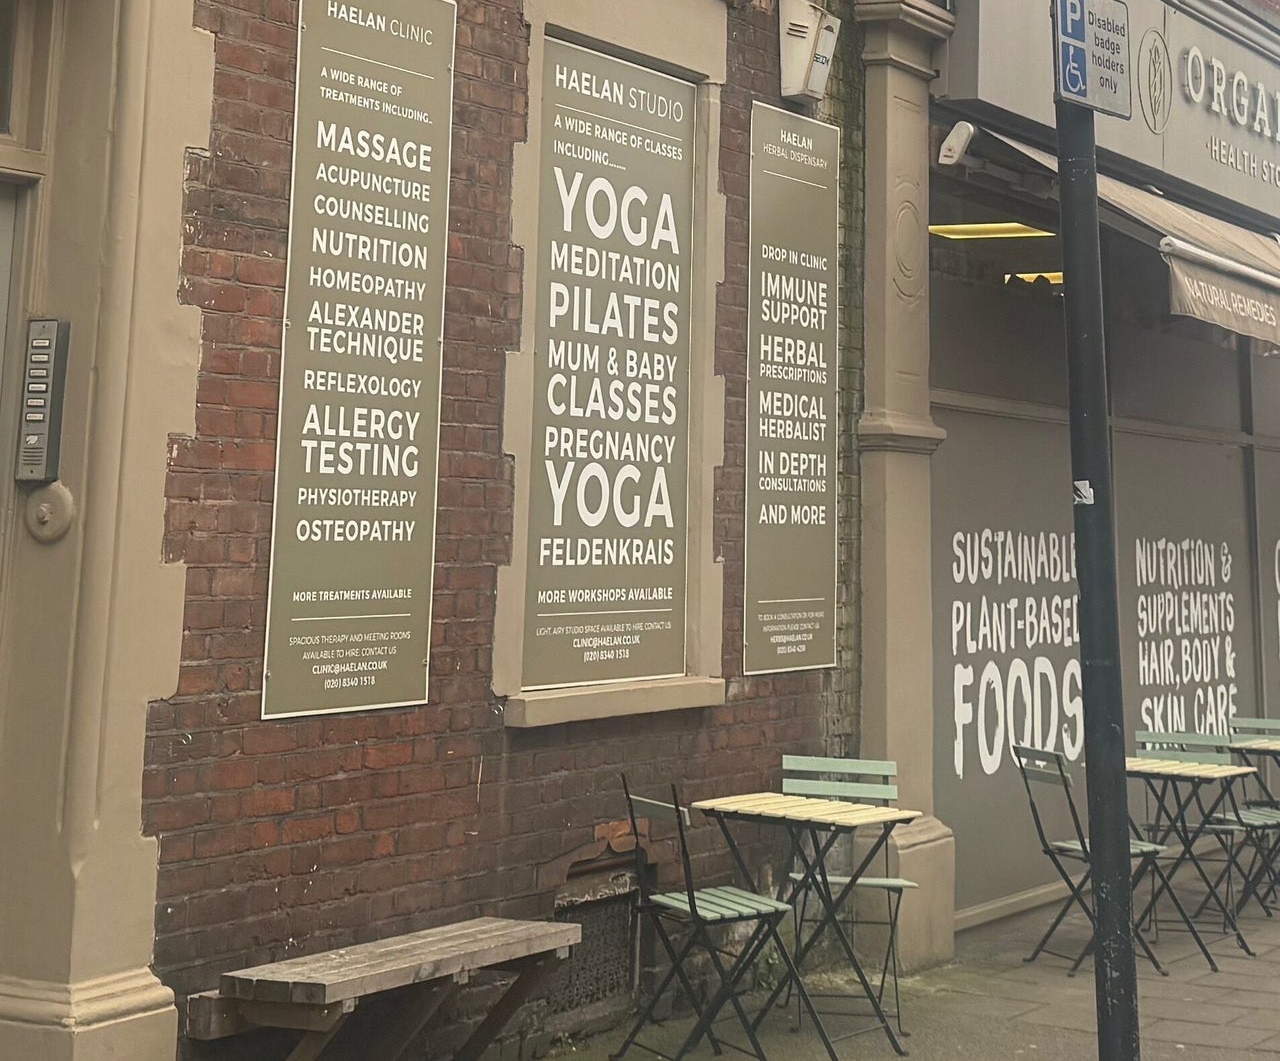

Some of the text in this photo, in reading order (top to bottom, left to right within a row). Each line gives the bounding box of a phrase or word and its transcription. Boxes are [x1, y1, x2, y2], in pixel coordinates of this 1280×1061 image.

[327, 0, 433, 45] HAELAN CLINIC
[1088, 11, 1126, 37] Disabled
[1092, 50, 1124, 74] holders
[1094, 33, 1120, 55] badge
[555, 64, 683, 123] HAELAN STUDIO
[1100, 76, 1118, 94] only
[317, 120, 432, 172] MASSAGE
[780, 129, 813, 151] HAELAN
[1210, 136, 1257, 178] HEALTH
[316, 163, 430, 202] ACUPUNCTURE
[313, 195, 429, 233] COUNSELLING
[553, 166, 680, 255] YOGA
[312, 228, 427, 270] NUTRITION
[551, 240, 680, 293] MEDITATION
[762, 244, 828, 271] DROP IN CLINIC
[309, 266, 426, 302] HOMEOPATHY
[761, 271, 828, 308] IMMUNE
[1184, 276, 1277, 327] NATURAL REMEDIES
[308, 301, 424, 336] ALEXANDER
[549, 281, 679, 345] PILATES
[761, 299, 827, 331] SUPPORT
[307, 327, 423, 363] TECHNIQUE
[548, 339, 677, 382] MUM & BABY
[760, 334, 827, 369] HERBAL
[304, 369, 421, 398] REFLEXOLOGY
[759, 363, 827, 384] PRESCRIPTIONS
[547, 373, 677, 426] CLASSES
[759, 391, 826, 420] MEDICAL
[302, 404, 420, 441] ALLERGY
[759, 418, 826, 442] HERBALIST
[301, 439, 418, 477] TESTING
[545, 426, 676, 464] PREGNANCY
[759, 450, 826, 477] IN DEPTH
[298, 487, 417, 508] PHYSIOTHERAPY
[545, 460, 674, 528] YOGA
[759, 476, 826, 492] CONSULTATIONS
[296, 519, 415, 542] OSTEOPATHY
[759, 504, 826, 525] AND MORE
[539, 538, 674, 566] FELDENKRAIS
[1221, 542, 1233, 583] &
[293, 588, 412, 602] MORE TREATMENTS AVAILABLE
[537, 587, 673, 604] MORE WORKSHOPS AVAILABLE
[1137, 591, 1234, 638] SUPPLEMENTS
[1138, 635, 1236, 690] HAIR, BODY &
[954, 656, 1085, 780] FOODS
[1141, 683, 1239, 750] SKIN CARE
